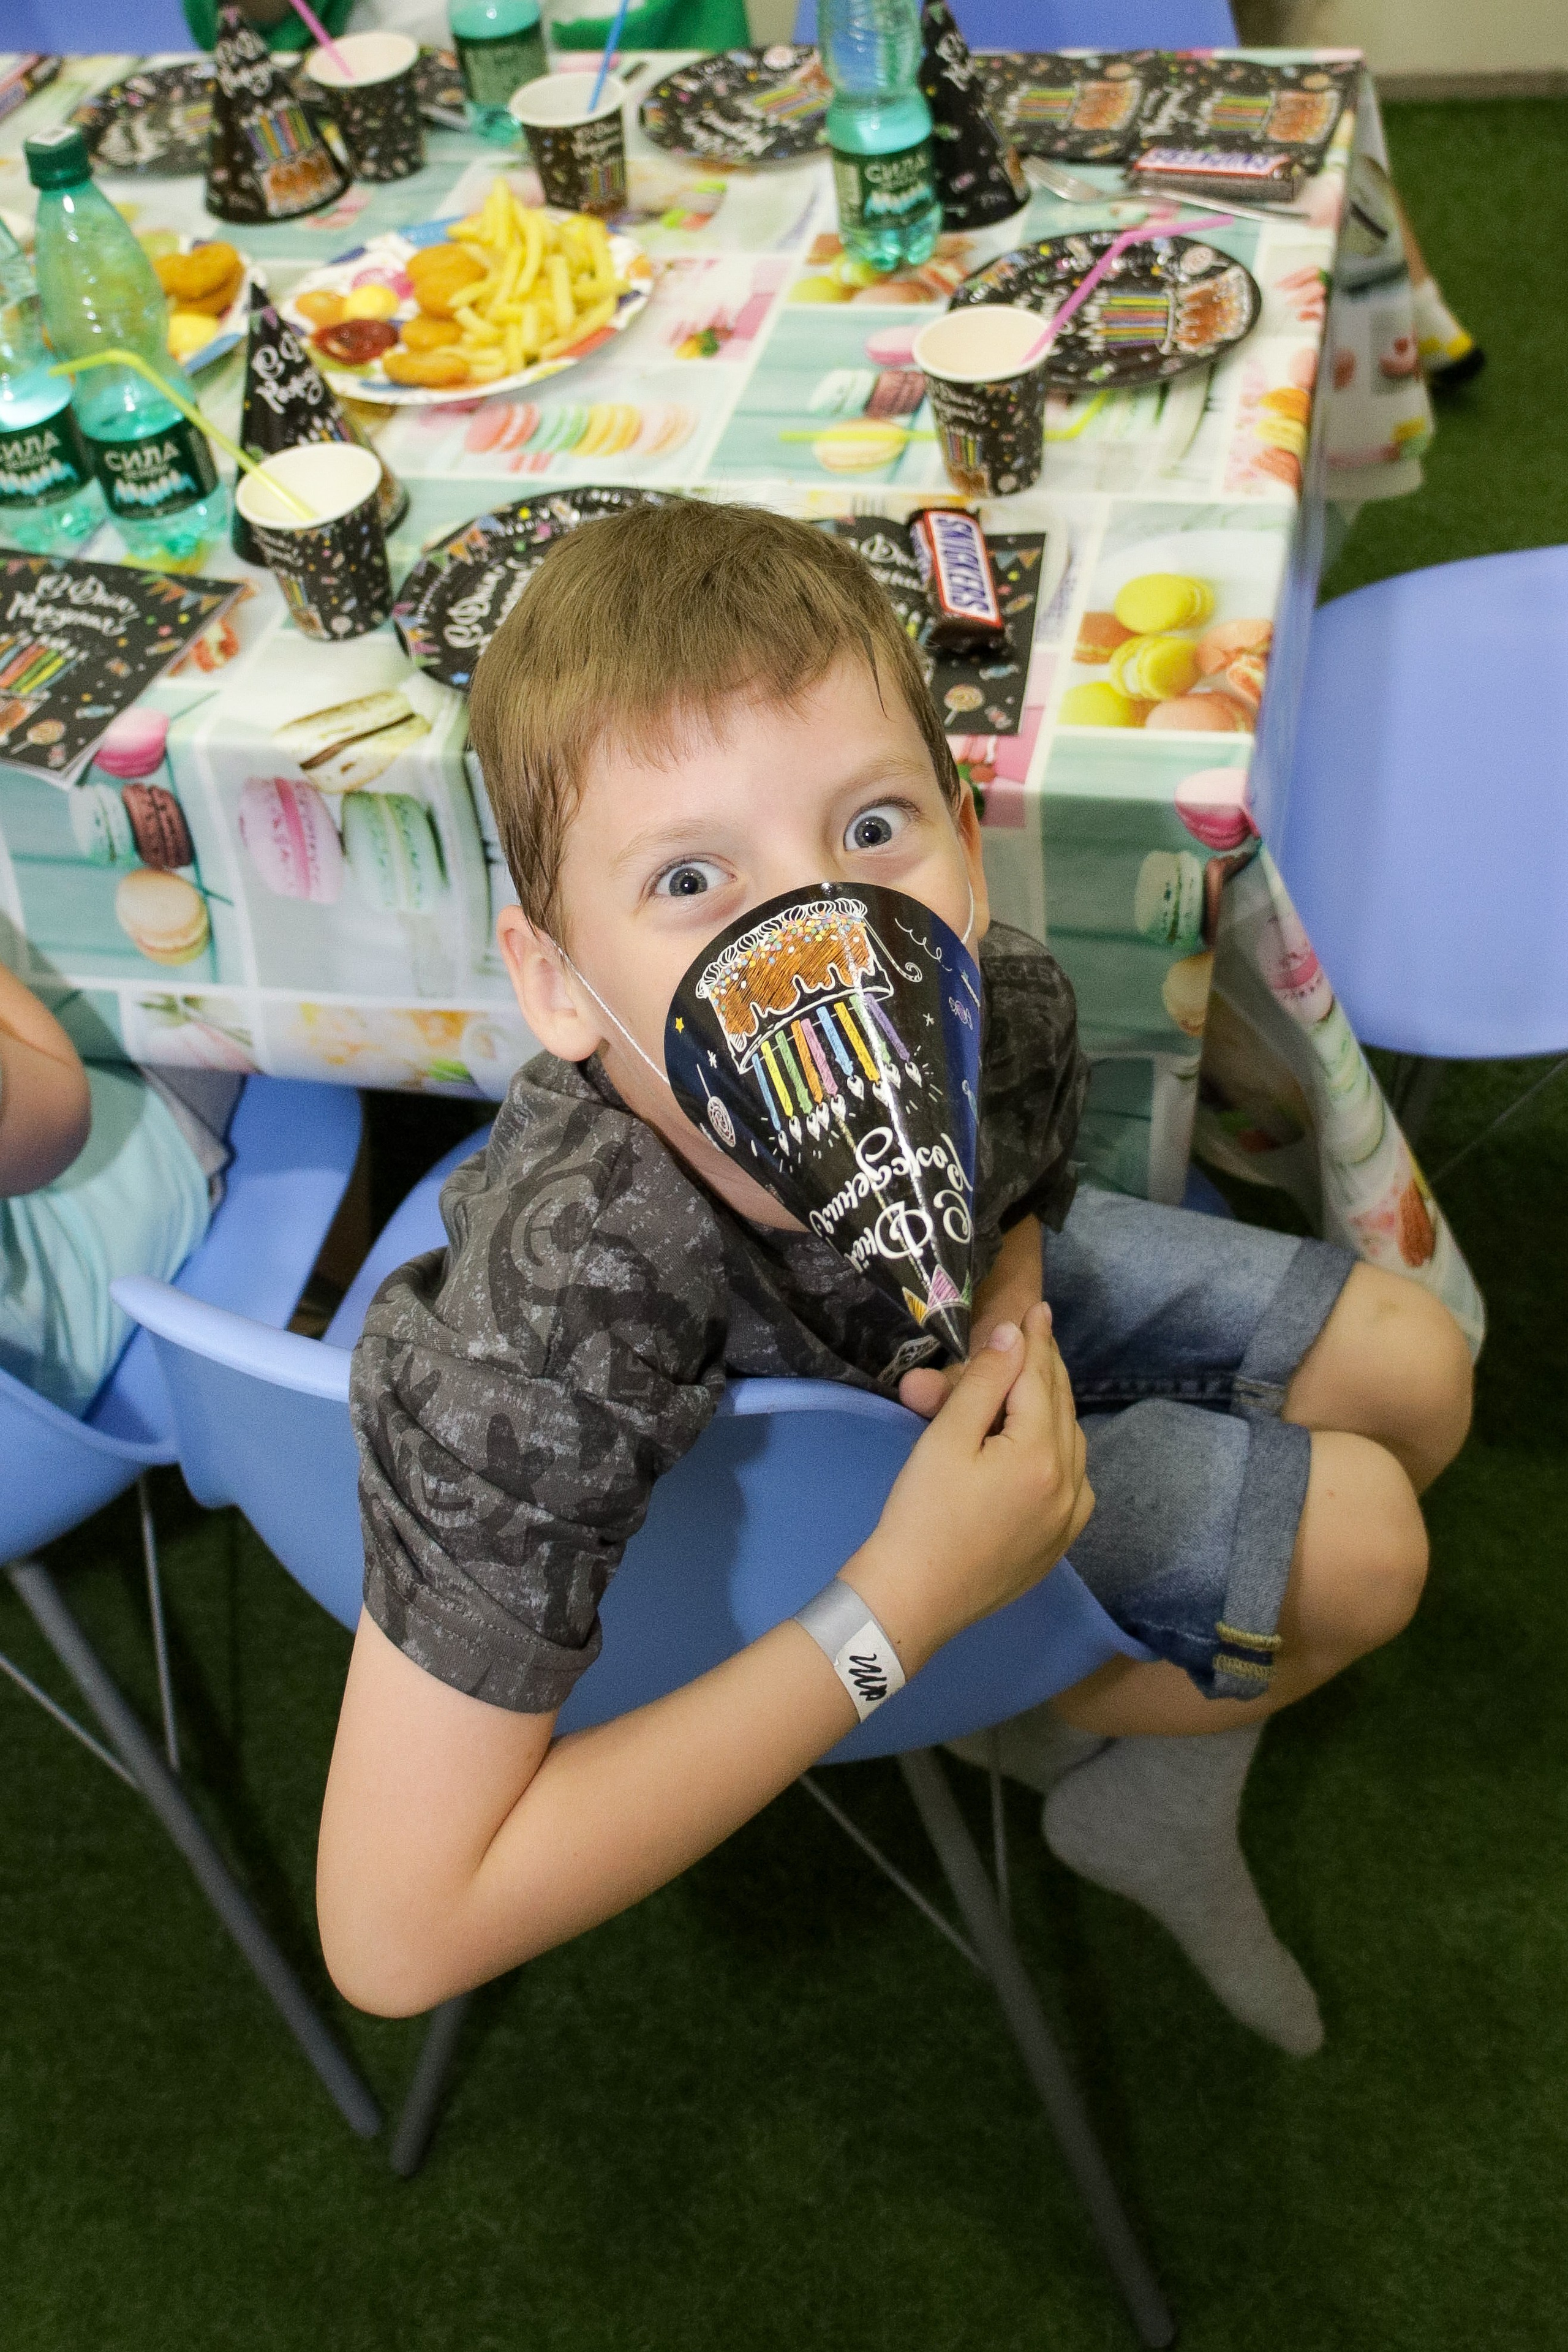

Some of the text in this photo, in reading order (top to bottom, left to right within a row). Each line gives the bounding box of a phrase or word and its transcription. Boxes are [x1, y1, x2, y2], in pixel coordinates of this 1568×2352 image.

[0, 430, 61, 459] ИЛА
[105, 442, 181, 471] СИЛА
[935, 518, 989, 611] SNICKERS
